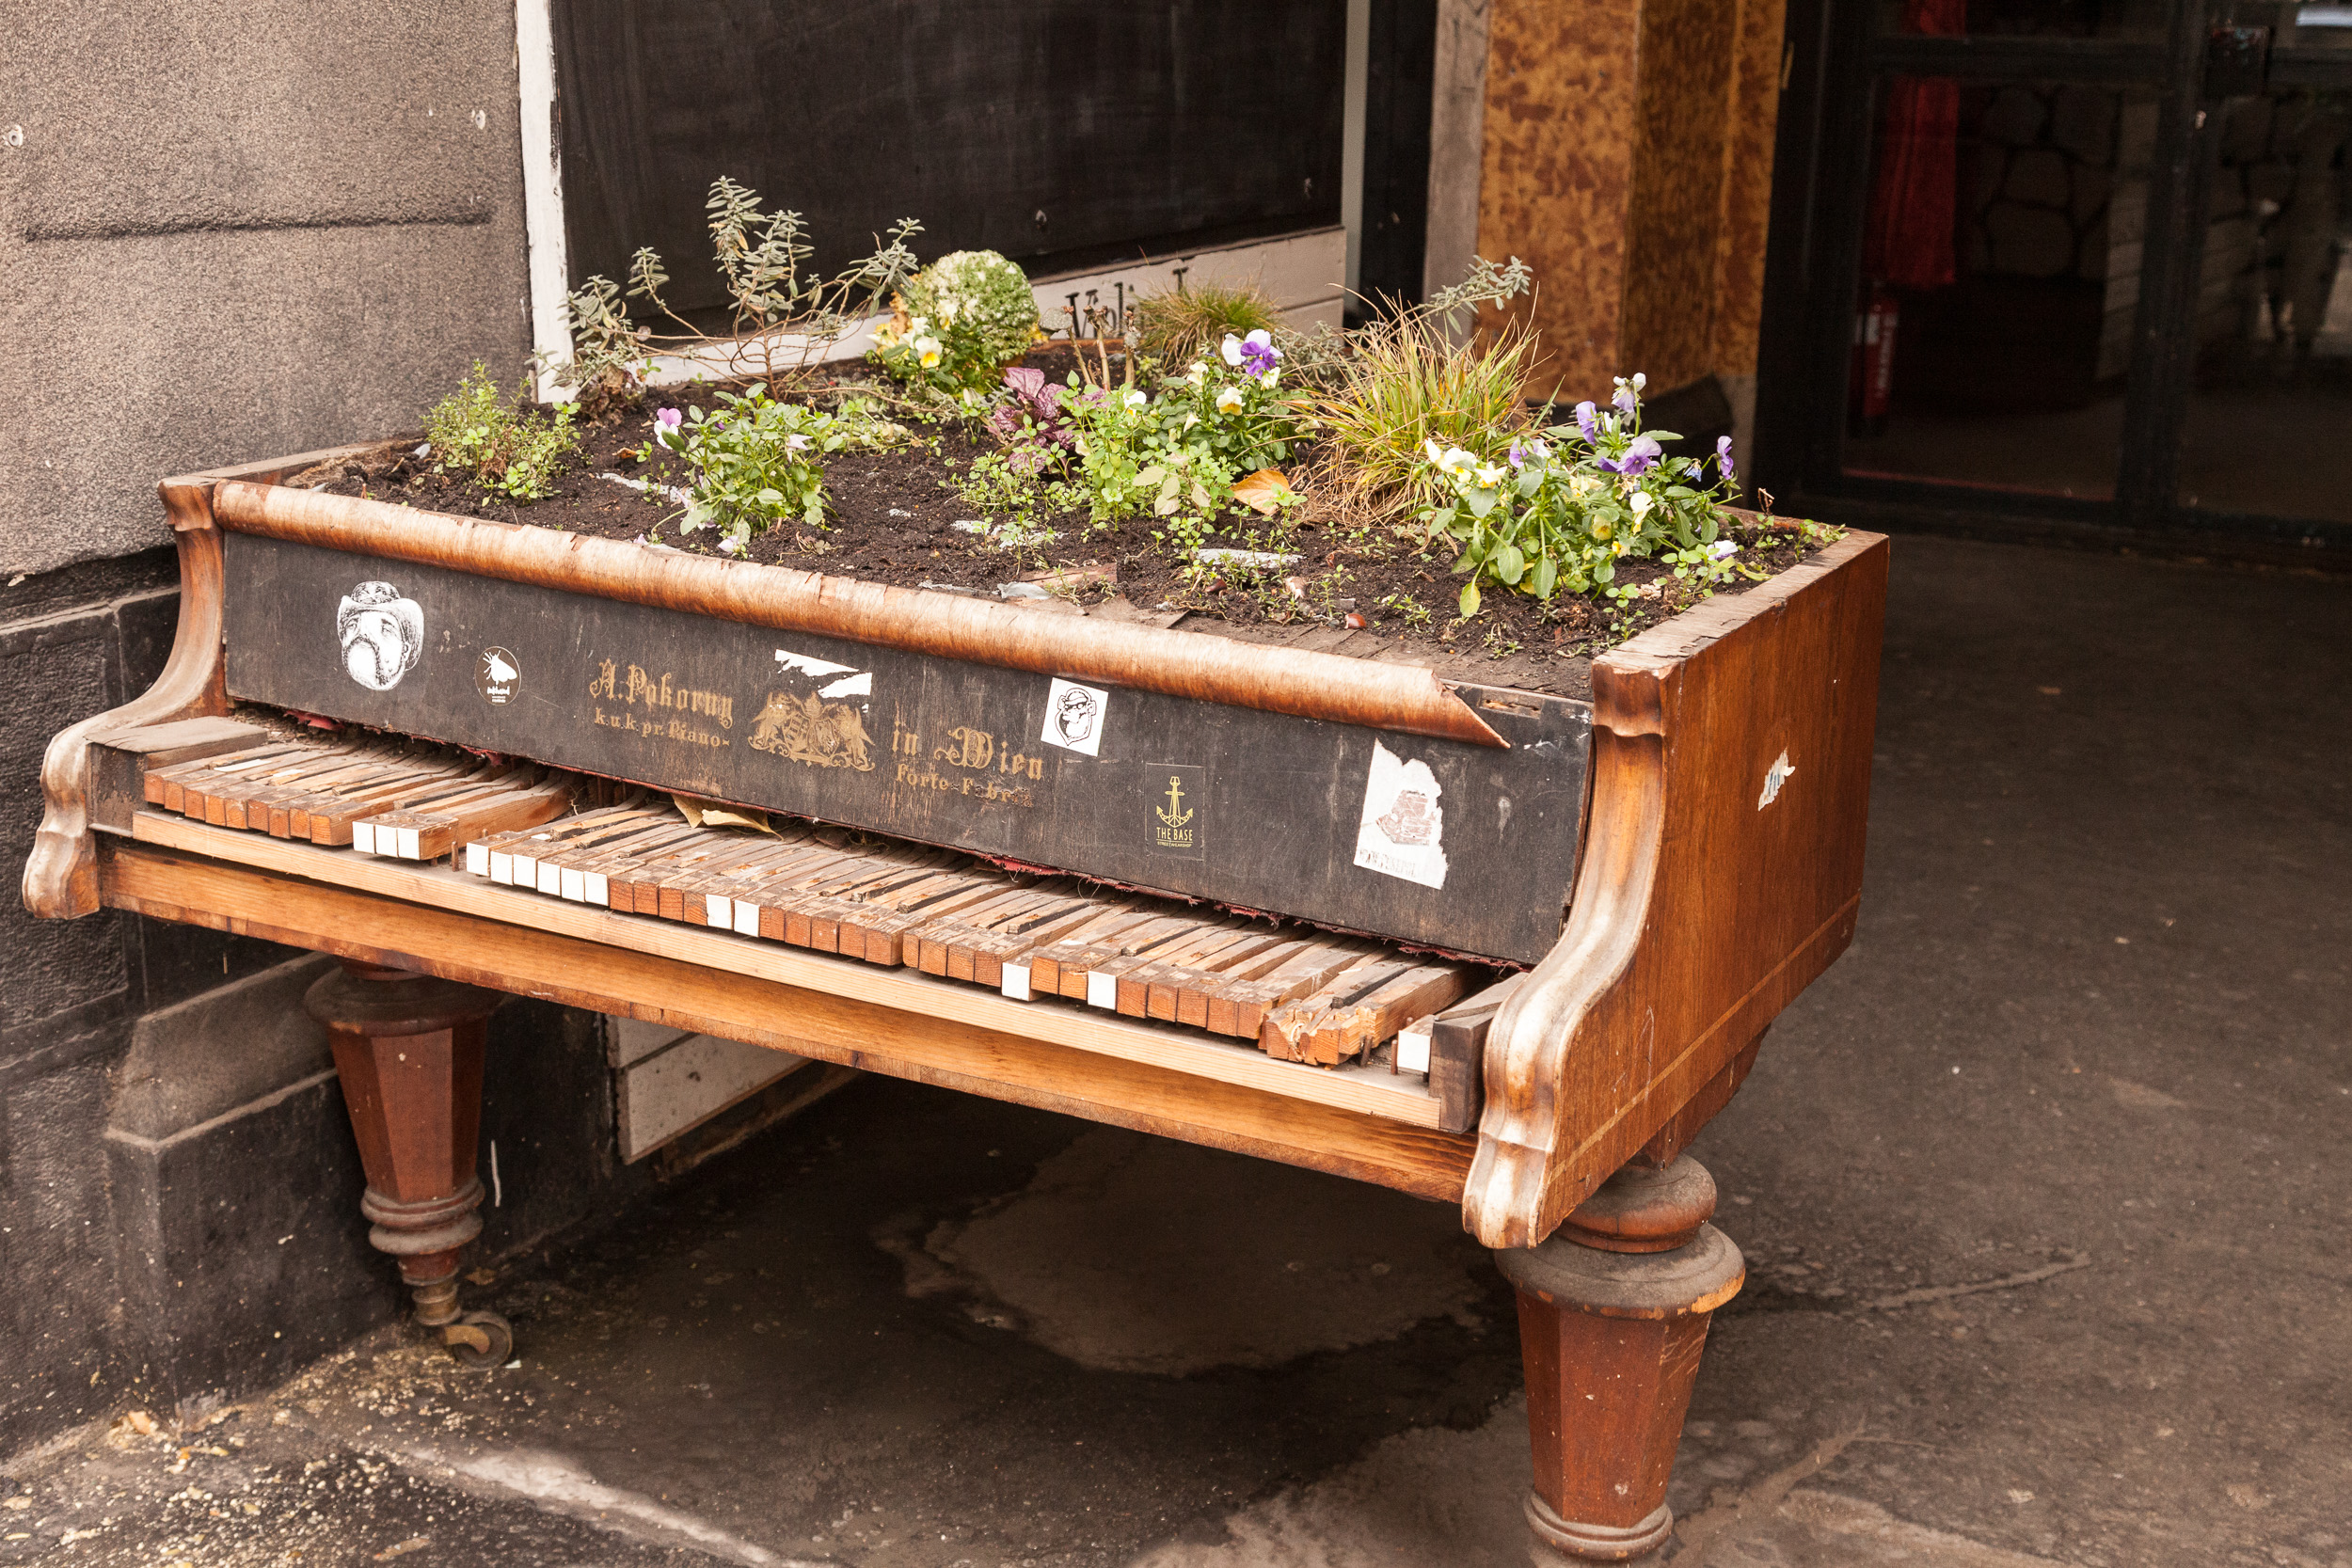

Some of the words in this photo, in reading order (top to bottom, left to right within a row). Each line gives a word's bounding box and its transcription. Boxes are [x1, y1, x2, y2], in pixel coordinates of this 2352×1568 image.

[892, 720, 918, 756] in
[933, 726, 1042, 781] Wien
[1156, 827, 1171, 840] THE
[1173, 829, 1193, 842] BASE
